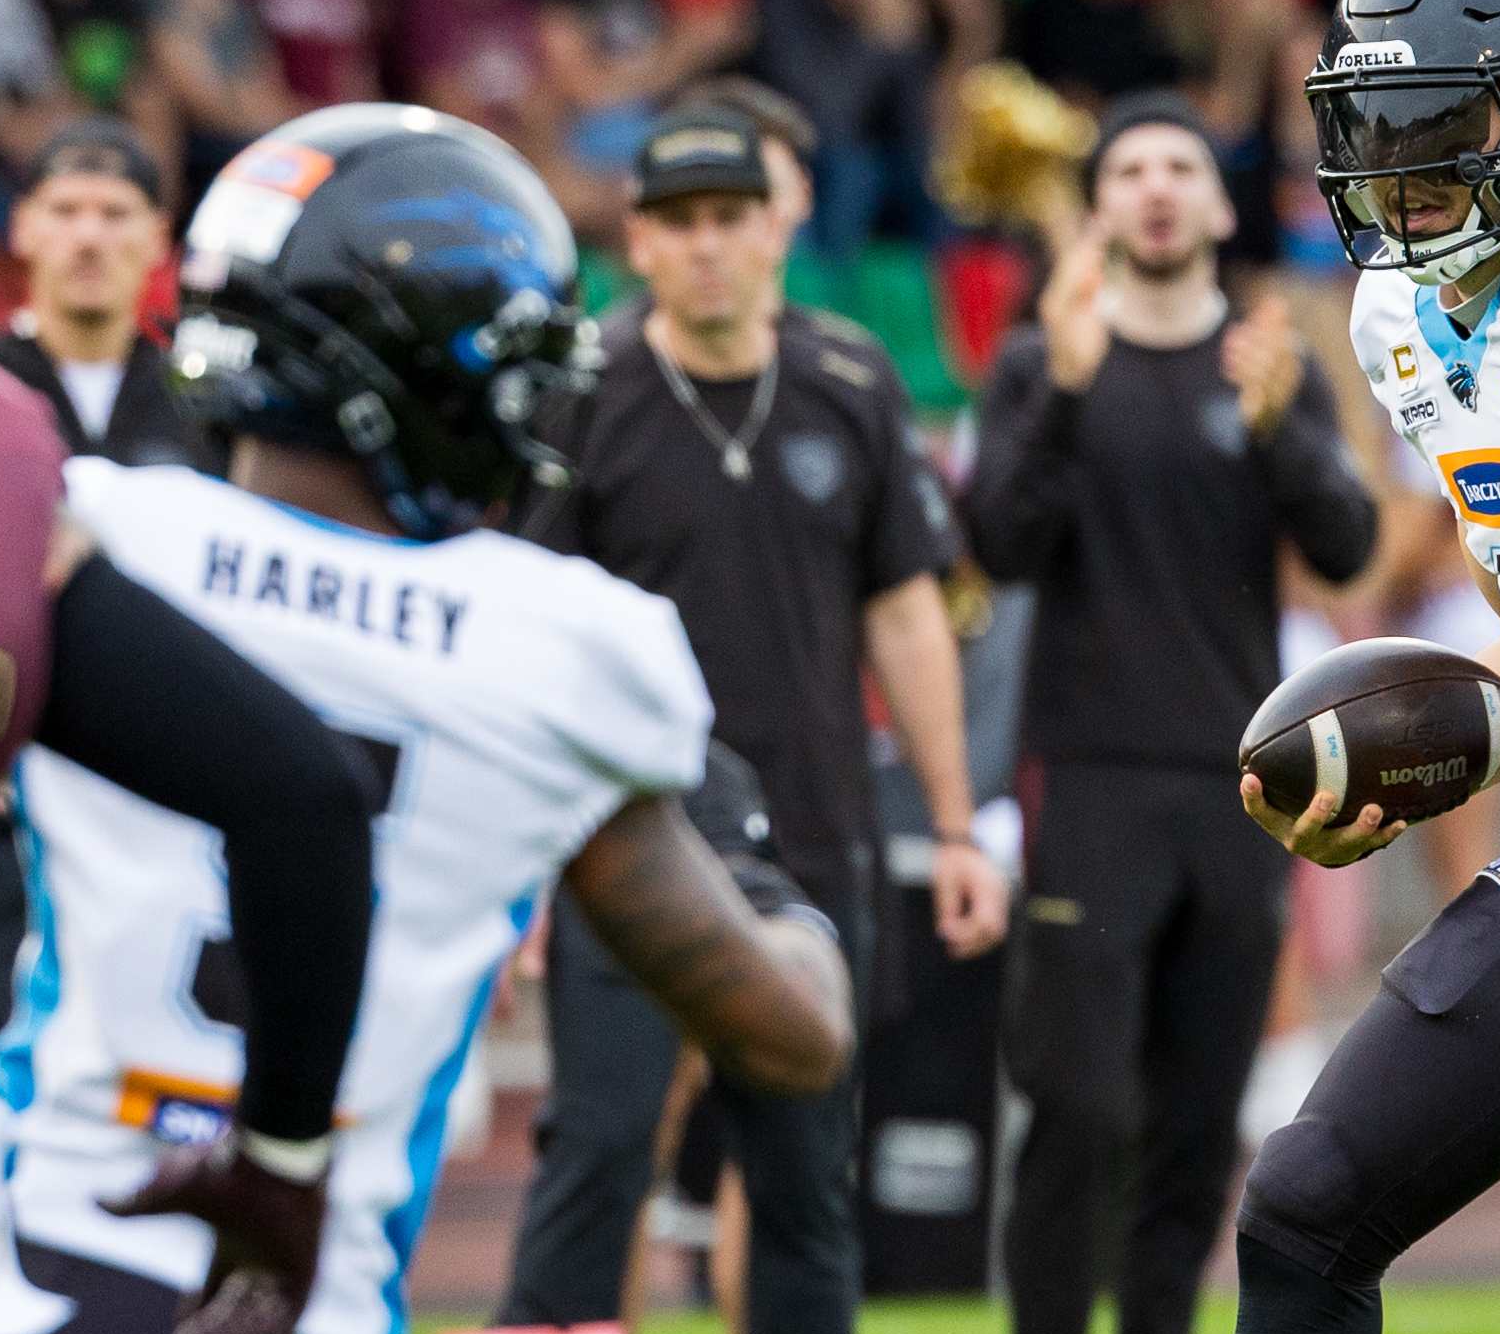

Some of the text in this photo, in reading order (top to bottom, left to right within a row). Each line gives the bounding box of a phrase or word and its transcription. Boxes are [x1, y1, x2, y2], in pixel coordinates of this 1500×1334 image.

[1339, 52, 1403, 67] FORELLE
[1339, 139, 1369, 192] Riddll
[1392, 344, 1417, 380] C
[202, 533, 469, 656] HARLEY
[1380, 755, 1468, 786] Wilson
